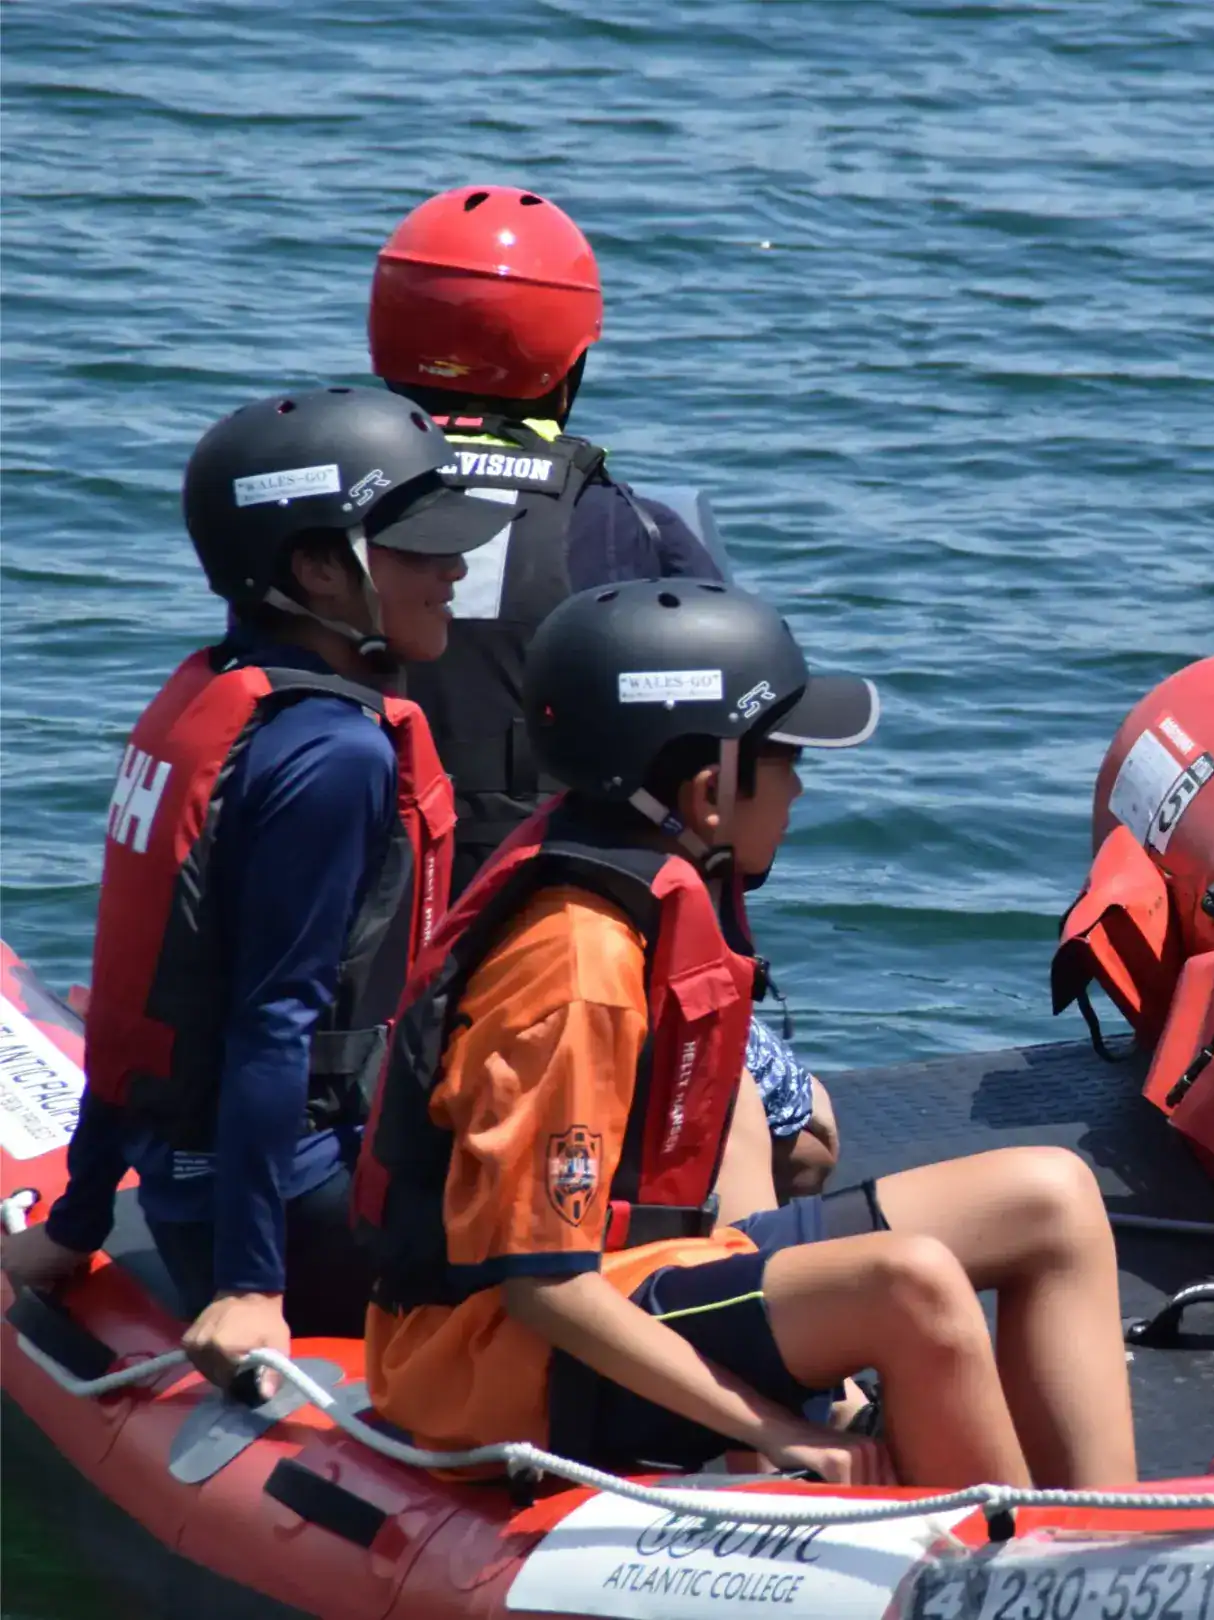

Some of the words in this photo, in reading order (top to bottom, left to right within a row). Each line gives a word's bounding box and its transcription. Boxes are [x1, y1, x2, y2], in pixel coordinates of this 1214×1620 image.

[107, 743, 173, 854] HH
[679, 1041, 696, 1087] HELLY
[603, 1563, 713, 1597] ATLANTIC
[709, 1569, 805, 1603] COLLEGE
